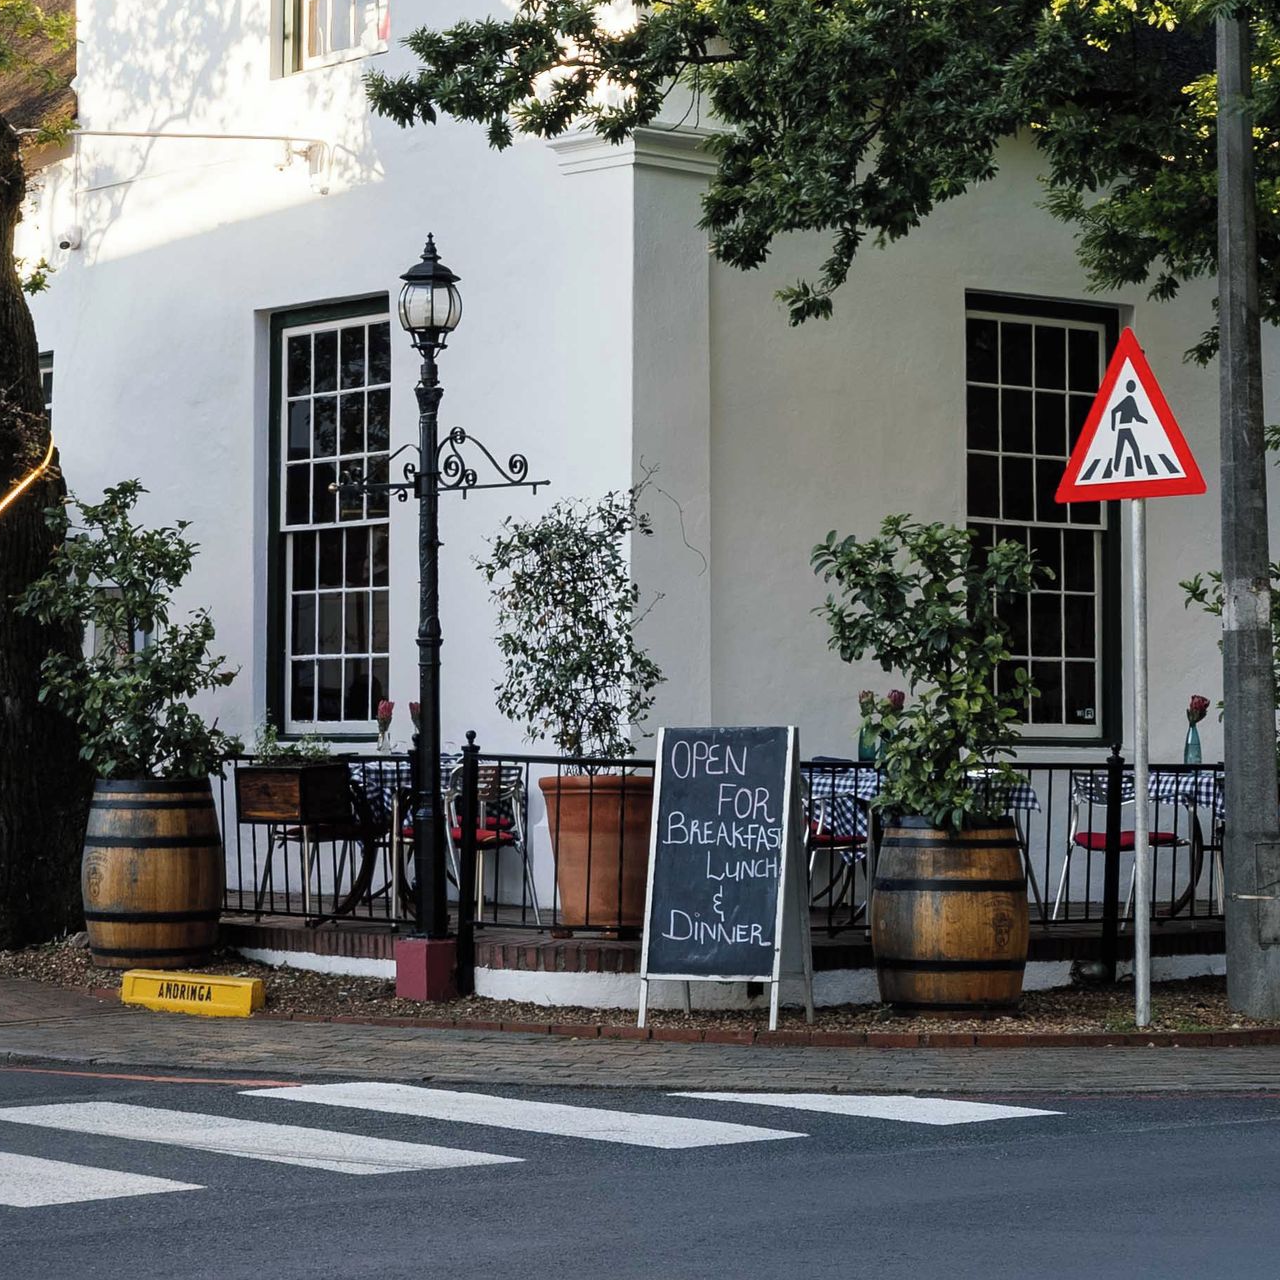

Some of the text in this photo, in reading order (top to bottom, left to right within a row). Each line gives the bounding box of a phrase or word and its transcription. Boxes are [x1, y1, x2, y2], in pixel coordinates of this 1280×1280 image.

[671, 740, 748, 779] OPEN
[718, 783, 776, 823] FOR
[662, 811, 782, 852] BREAKFAST
[713, 885, 725, 922] &
[158, 982, 212, 1002] ANDRINGA
